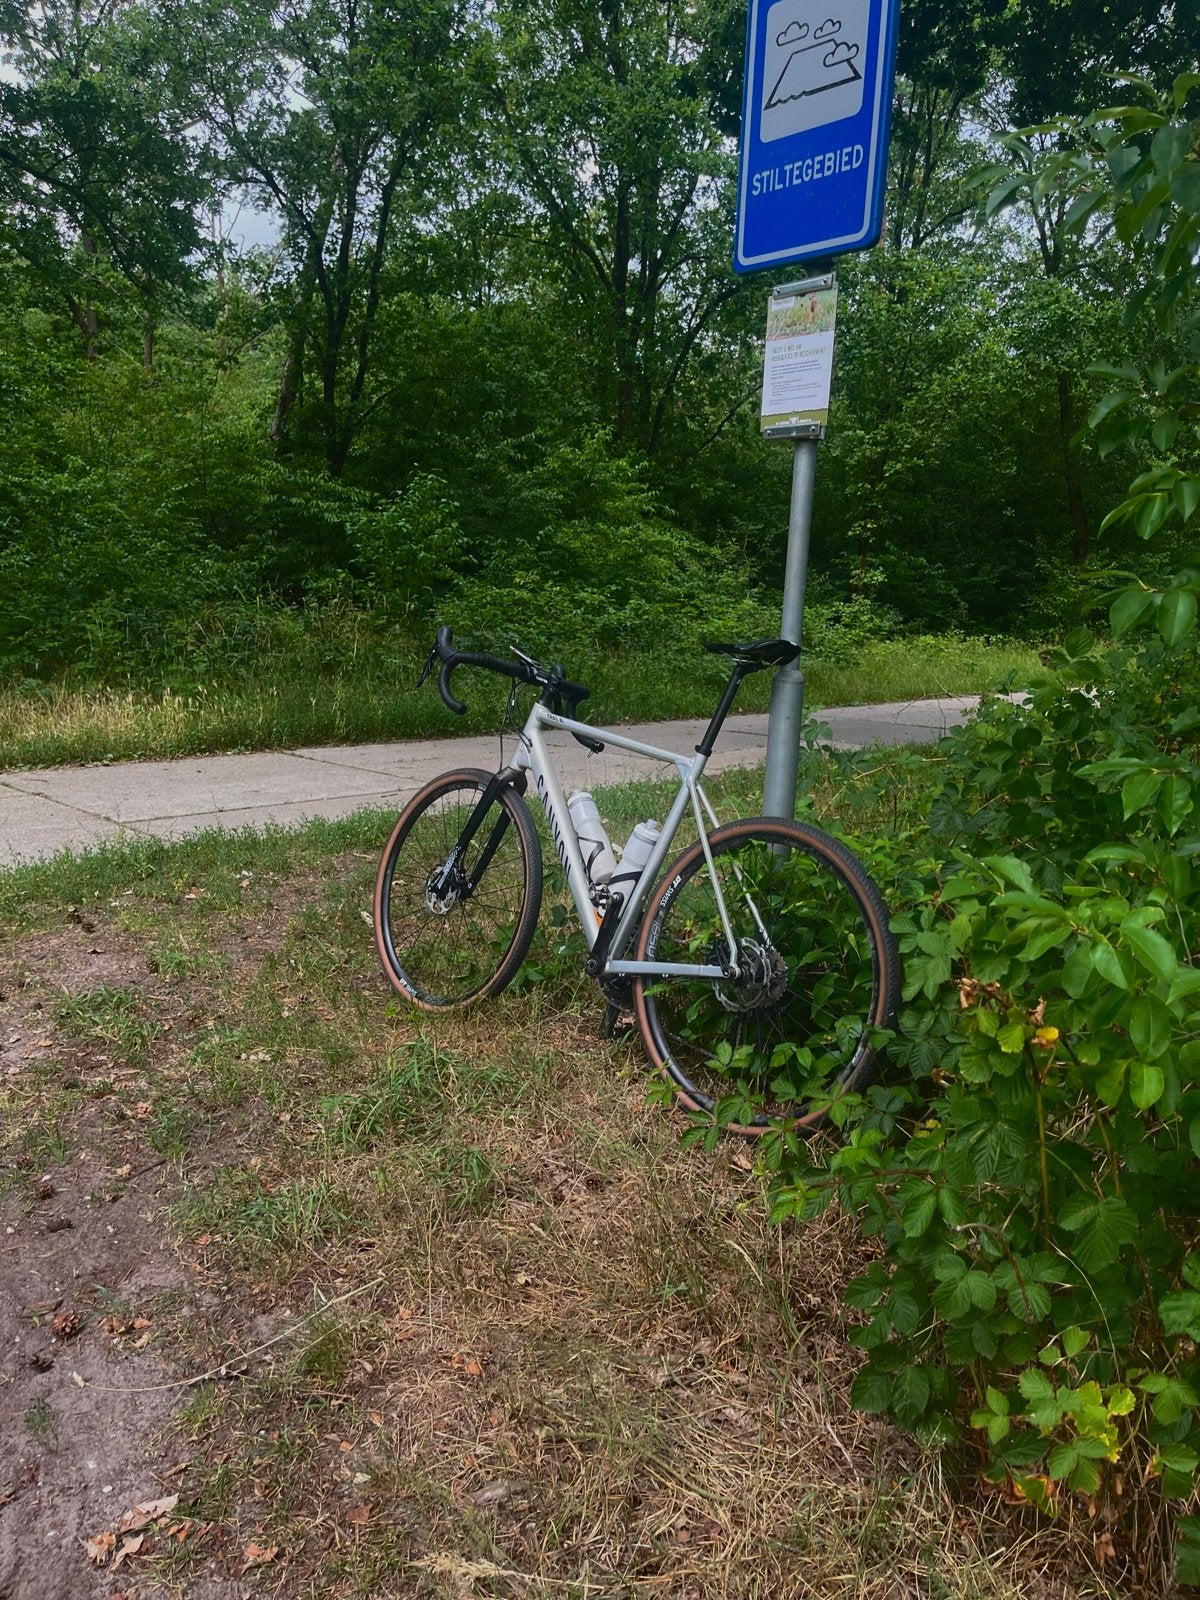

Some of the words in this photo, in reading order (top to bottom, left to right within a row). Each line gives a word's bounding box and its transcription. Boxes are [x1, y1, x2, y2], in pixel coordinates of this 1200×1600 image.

[751, 144, 864, 196] STILTEGEBIED
[537, 774, 572, 881] CANYON
[660, 885, 674, 908] SWISS
[673, 875, 682, 888] DT
